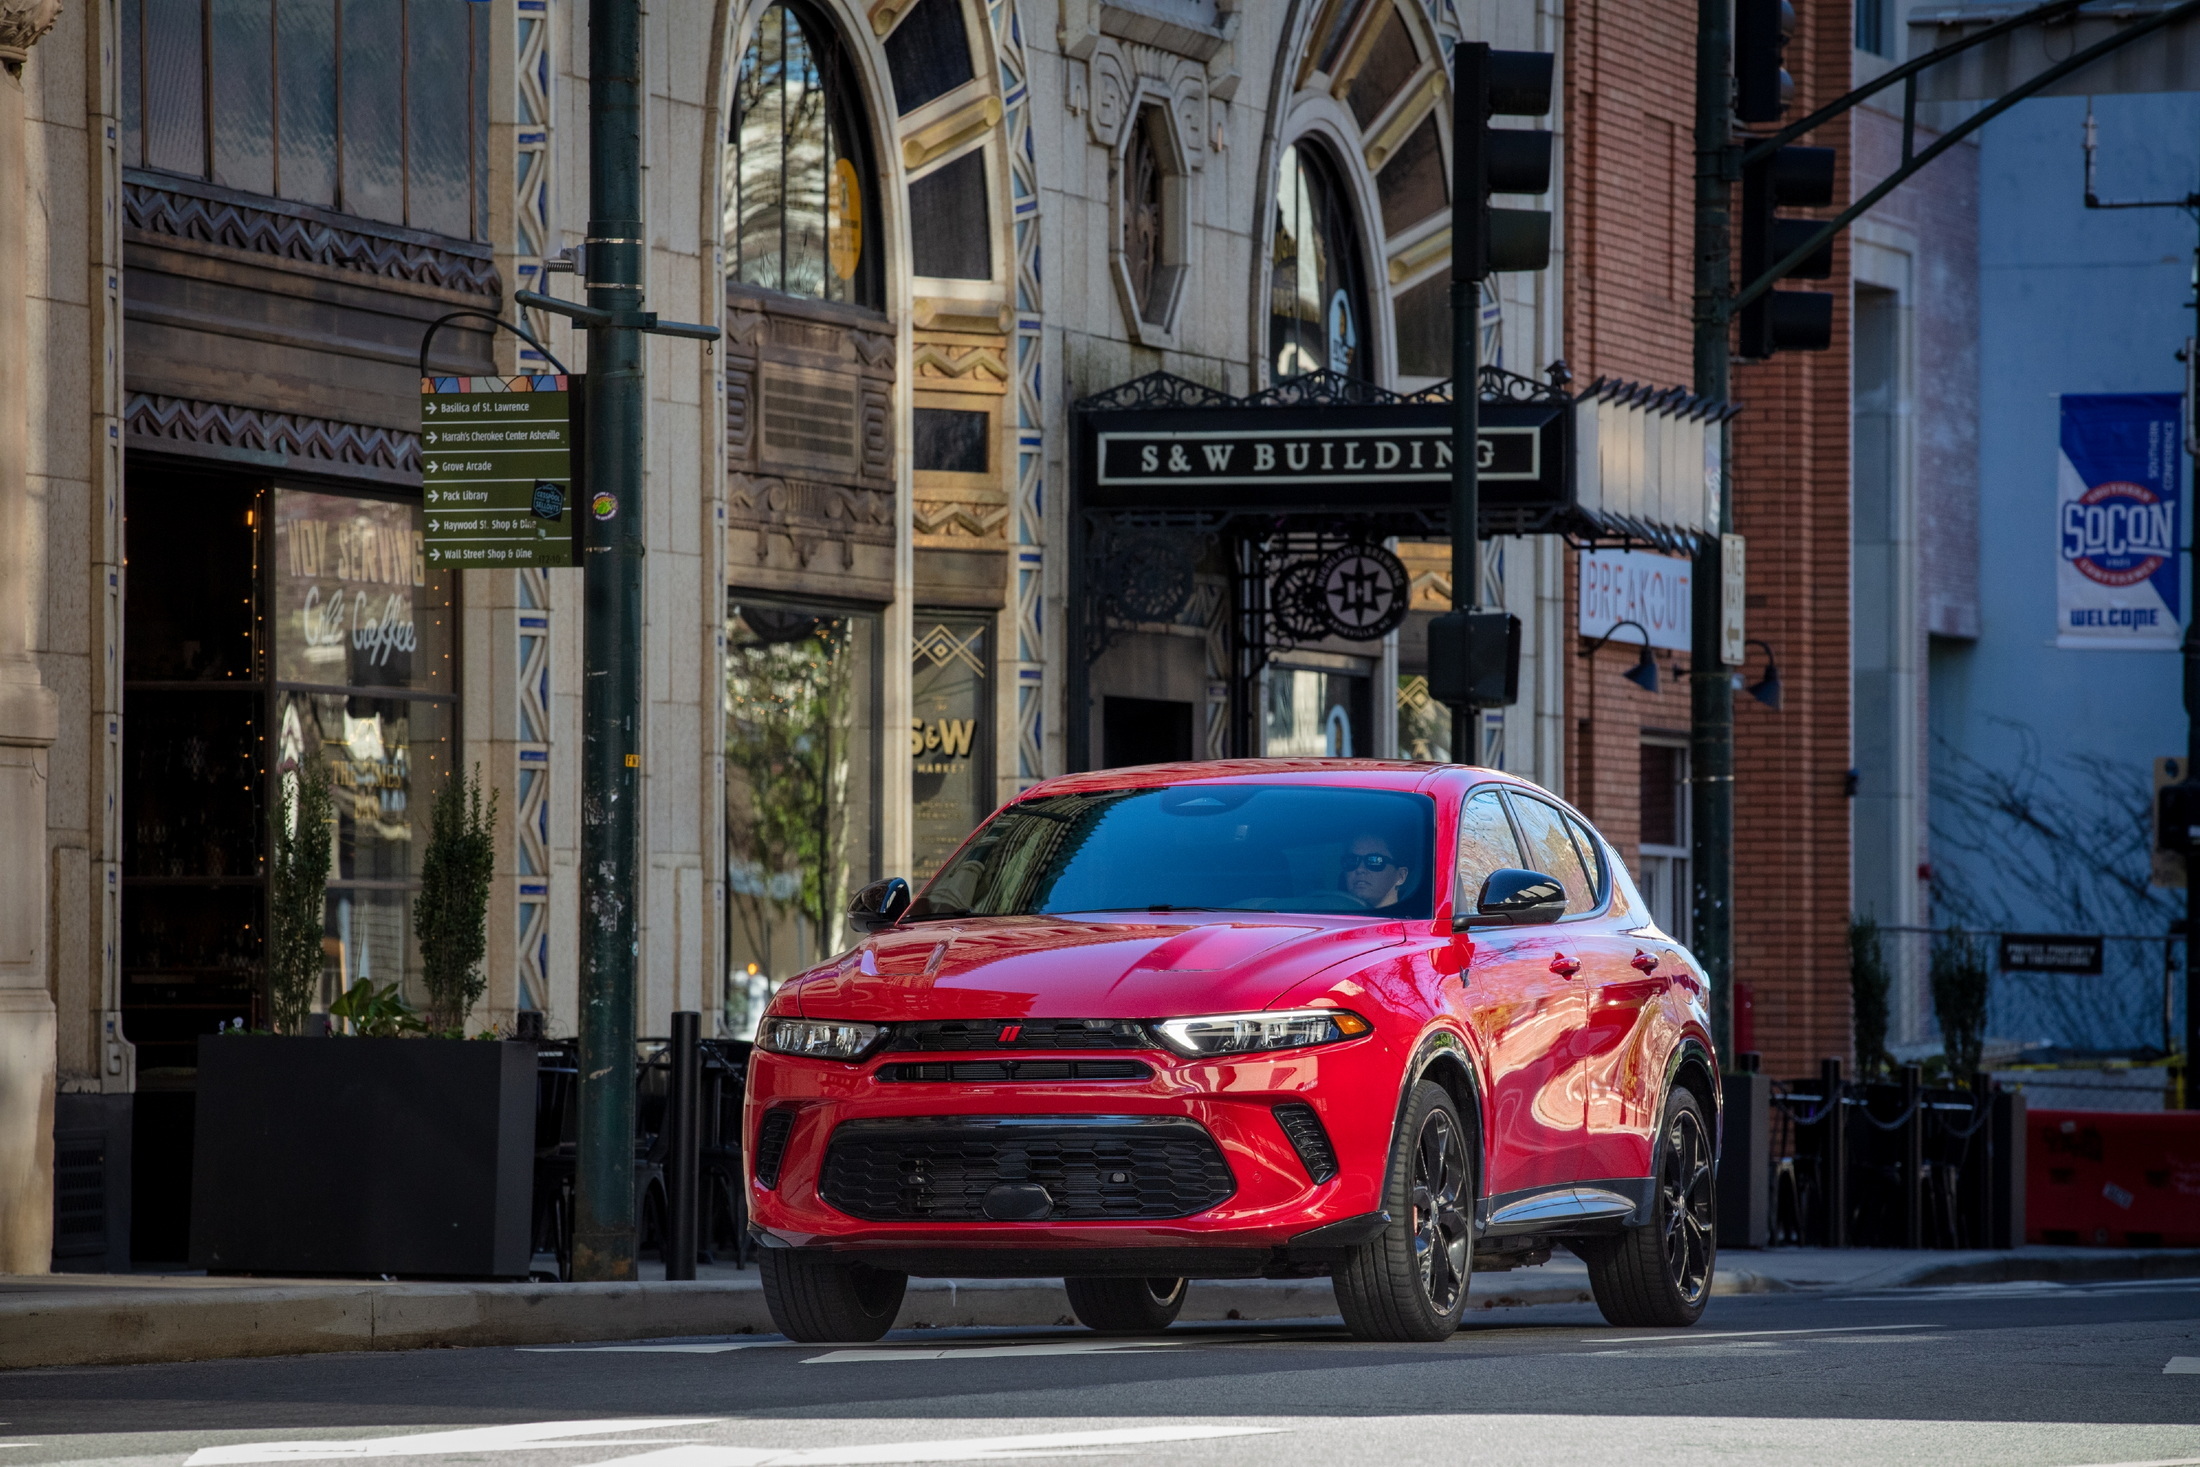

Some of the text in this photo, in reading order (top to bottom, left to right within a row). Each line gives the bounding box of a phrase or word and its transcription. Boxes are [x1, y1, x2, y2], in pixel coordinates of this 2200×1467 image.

[441, 402, 530, 413] Basilica of St. Lawrence
[442, 430, 560, 442] Harrah's Cherokee Center Asheville
[1253, 441, 1495, 471] BUILDING
[442, 461, 492, 471] Grove Arcade
[443, 490, 488, 502] Pack Library
[443, 520, 478, 532] Haywood
[491, 519, 511, 530] Shop
[512, 519, 518, 528] &
[338, 522, 425, 587] SERVING
[444, 549, 532, 560] Wall Street Shop & Dine
[1587, 560, 1689, 634] BREAKOUT
[2070, 609, 2159, 630] WELCOME
[353, 590, 417, 667] Coffee
[912, 718, 975, 756] S&W
[917, 763, 965, 774] MARKET
